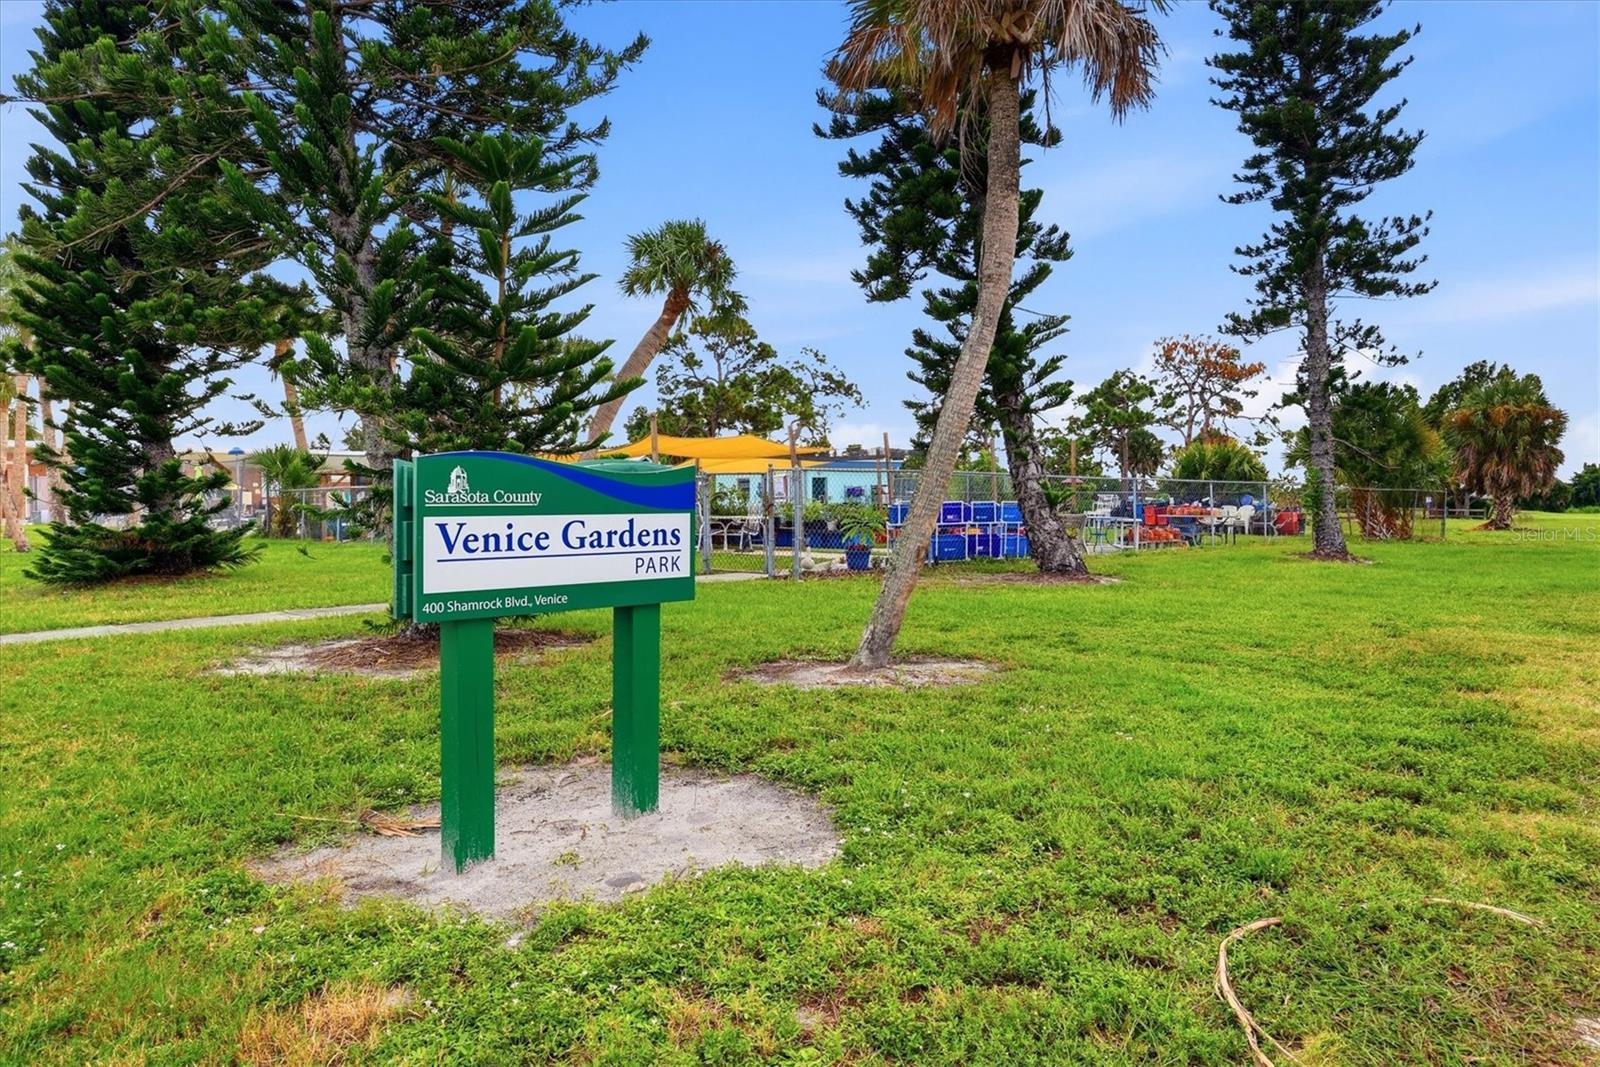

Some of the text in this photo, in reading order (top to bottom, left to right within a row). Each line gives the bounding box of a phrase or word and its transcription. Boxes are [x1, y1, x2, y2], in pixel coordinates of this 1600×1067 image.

[424, 489, 542, 506] Sarasota County
[435, 518, 681, 554] Venice Gardens
[635, 555, 681, 574] PARK
[422, 593, 568, 614] 400 Shamrock Blvd., Venice
